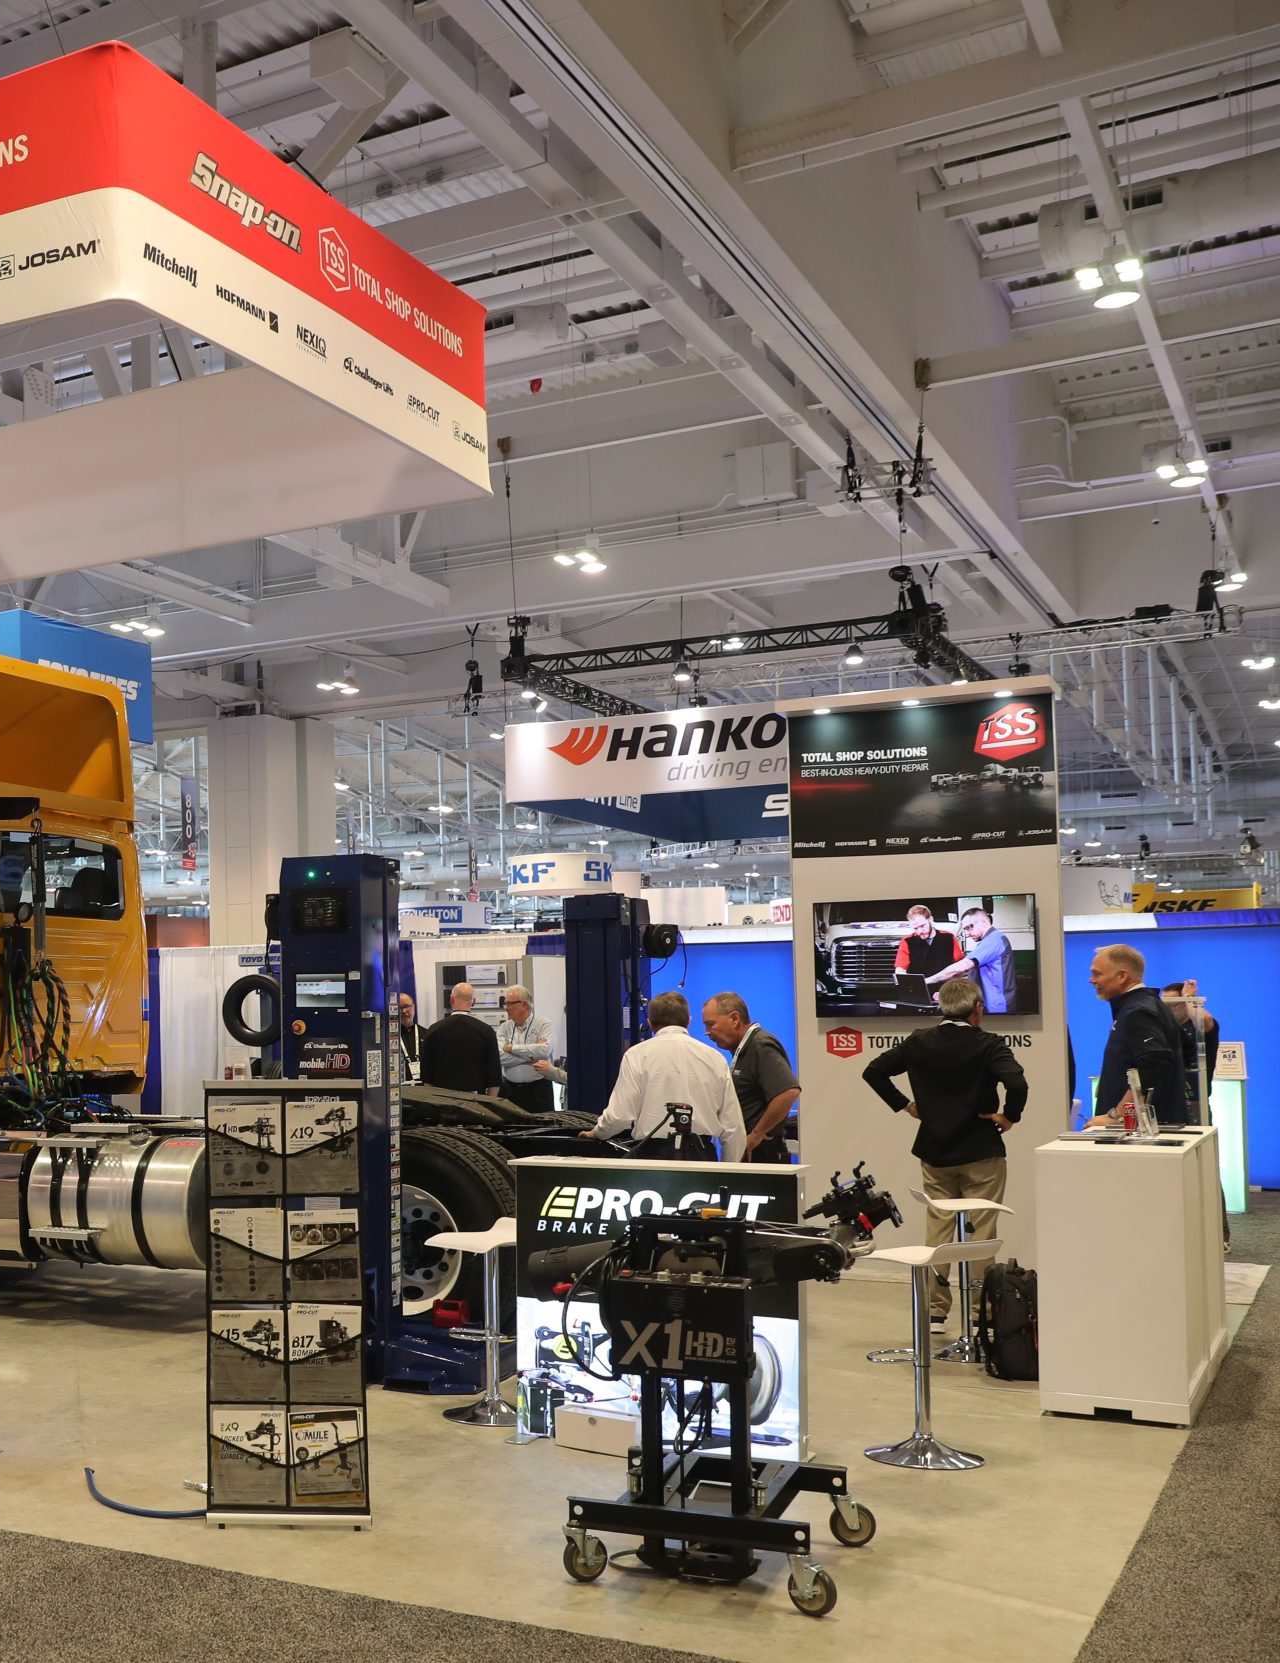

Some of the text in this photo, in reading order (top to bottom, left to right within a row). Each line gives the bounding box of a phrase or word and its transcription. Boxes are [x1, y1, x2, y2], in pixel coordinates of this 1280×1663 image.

[189, 151, 302, 254] Snap-on
[18, 240, 98, 272] JOSAM
[143, 243, 198, 288] Mitchell1
[322, 236, 346, 274] TSS
[216, 284, 266, 322] HOFMANN
[352, 263, 463, 358] TOTAL SHOP SOLUTIONS
[296, 324, 327, 358] NEXIQ
[354, 365, 382, 390] Challenger
[383, 381, 394, 396] Lifts
[411, 395, 440, 422] PRO-CUT
[461, 431, 486, 455] JOSAM
[982, 706, 1040, 742] TSS
[801, 746, 928, 764] TOTAL SHOP SOLUTIONS
[667, 757, 750, 782] driving
[801, 762, 929, 778] BEST-IN-CLASS HEAVY-DUTY REPAIR
[619, 795, 638, 809] Line
[885, 837, 909, 845] NEXIQ
[830, 1034, 857, 1047] TSS
[290, 1126, 314, 1139] X19
[537, 1219, 609, 1236] BRAKE
[292, 1335, 315, 1348] B17
[618, 1319, 683, 1370] X1
[304, 1430, 329, 1440] MULE
